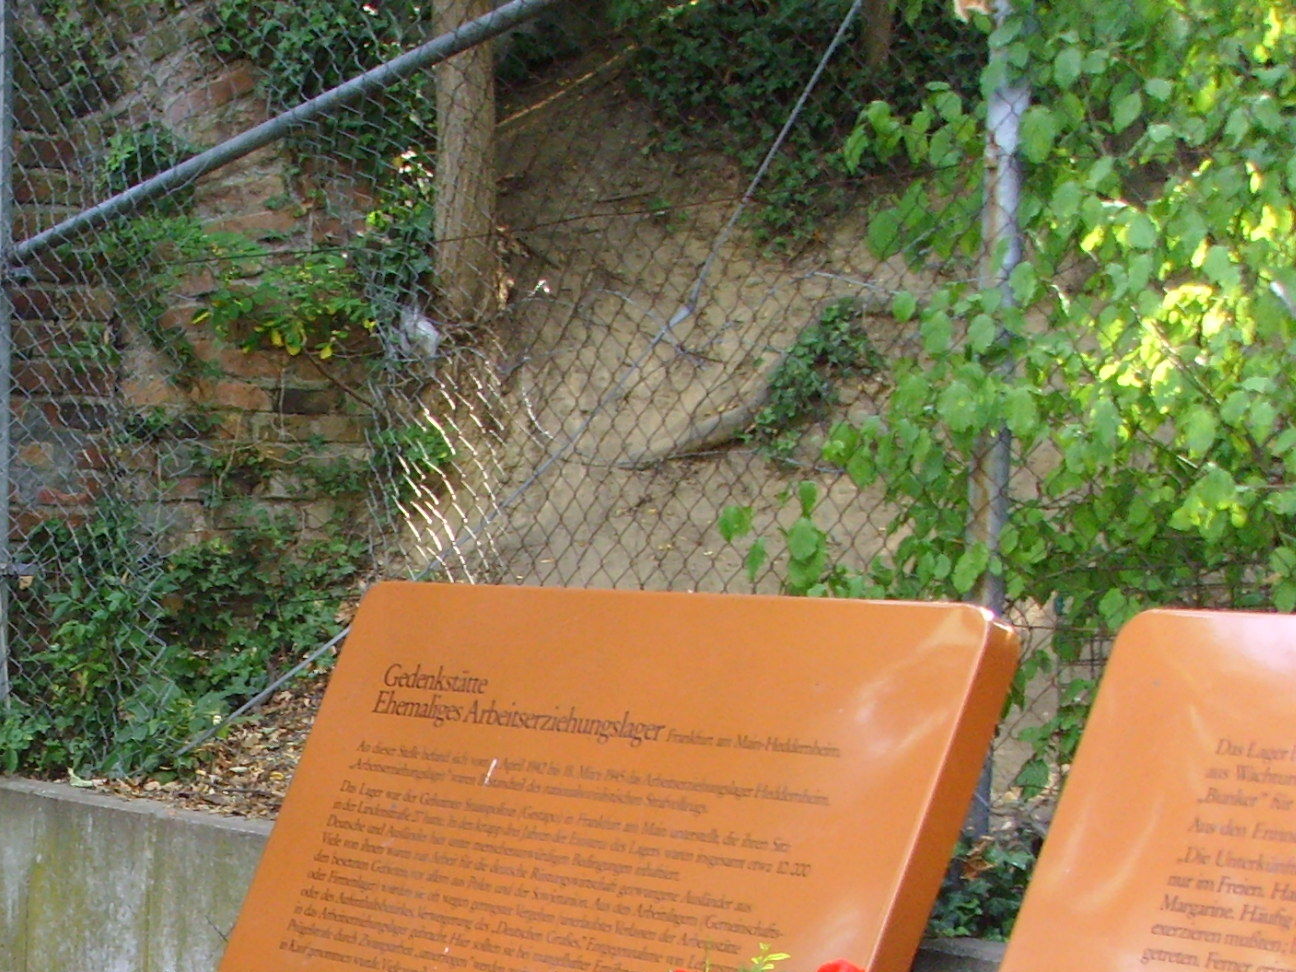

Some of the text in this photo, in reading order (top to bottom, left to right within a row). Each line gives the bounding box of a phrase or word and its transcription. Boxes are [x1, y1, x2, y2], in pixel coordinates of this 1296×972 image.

[383, 663, 489, 695] Gedenkstätte
[372, 690, 464, 728] Ehemaliges
[463, 699, 666, 748] Arbeitserziehungslager
